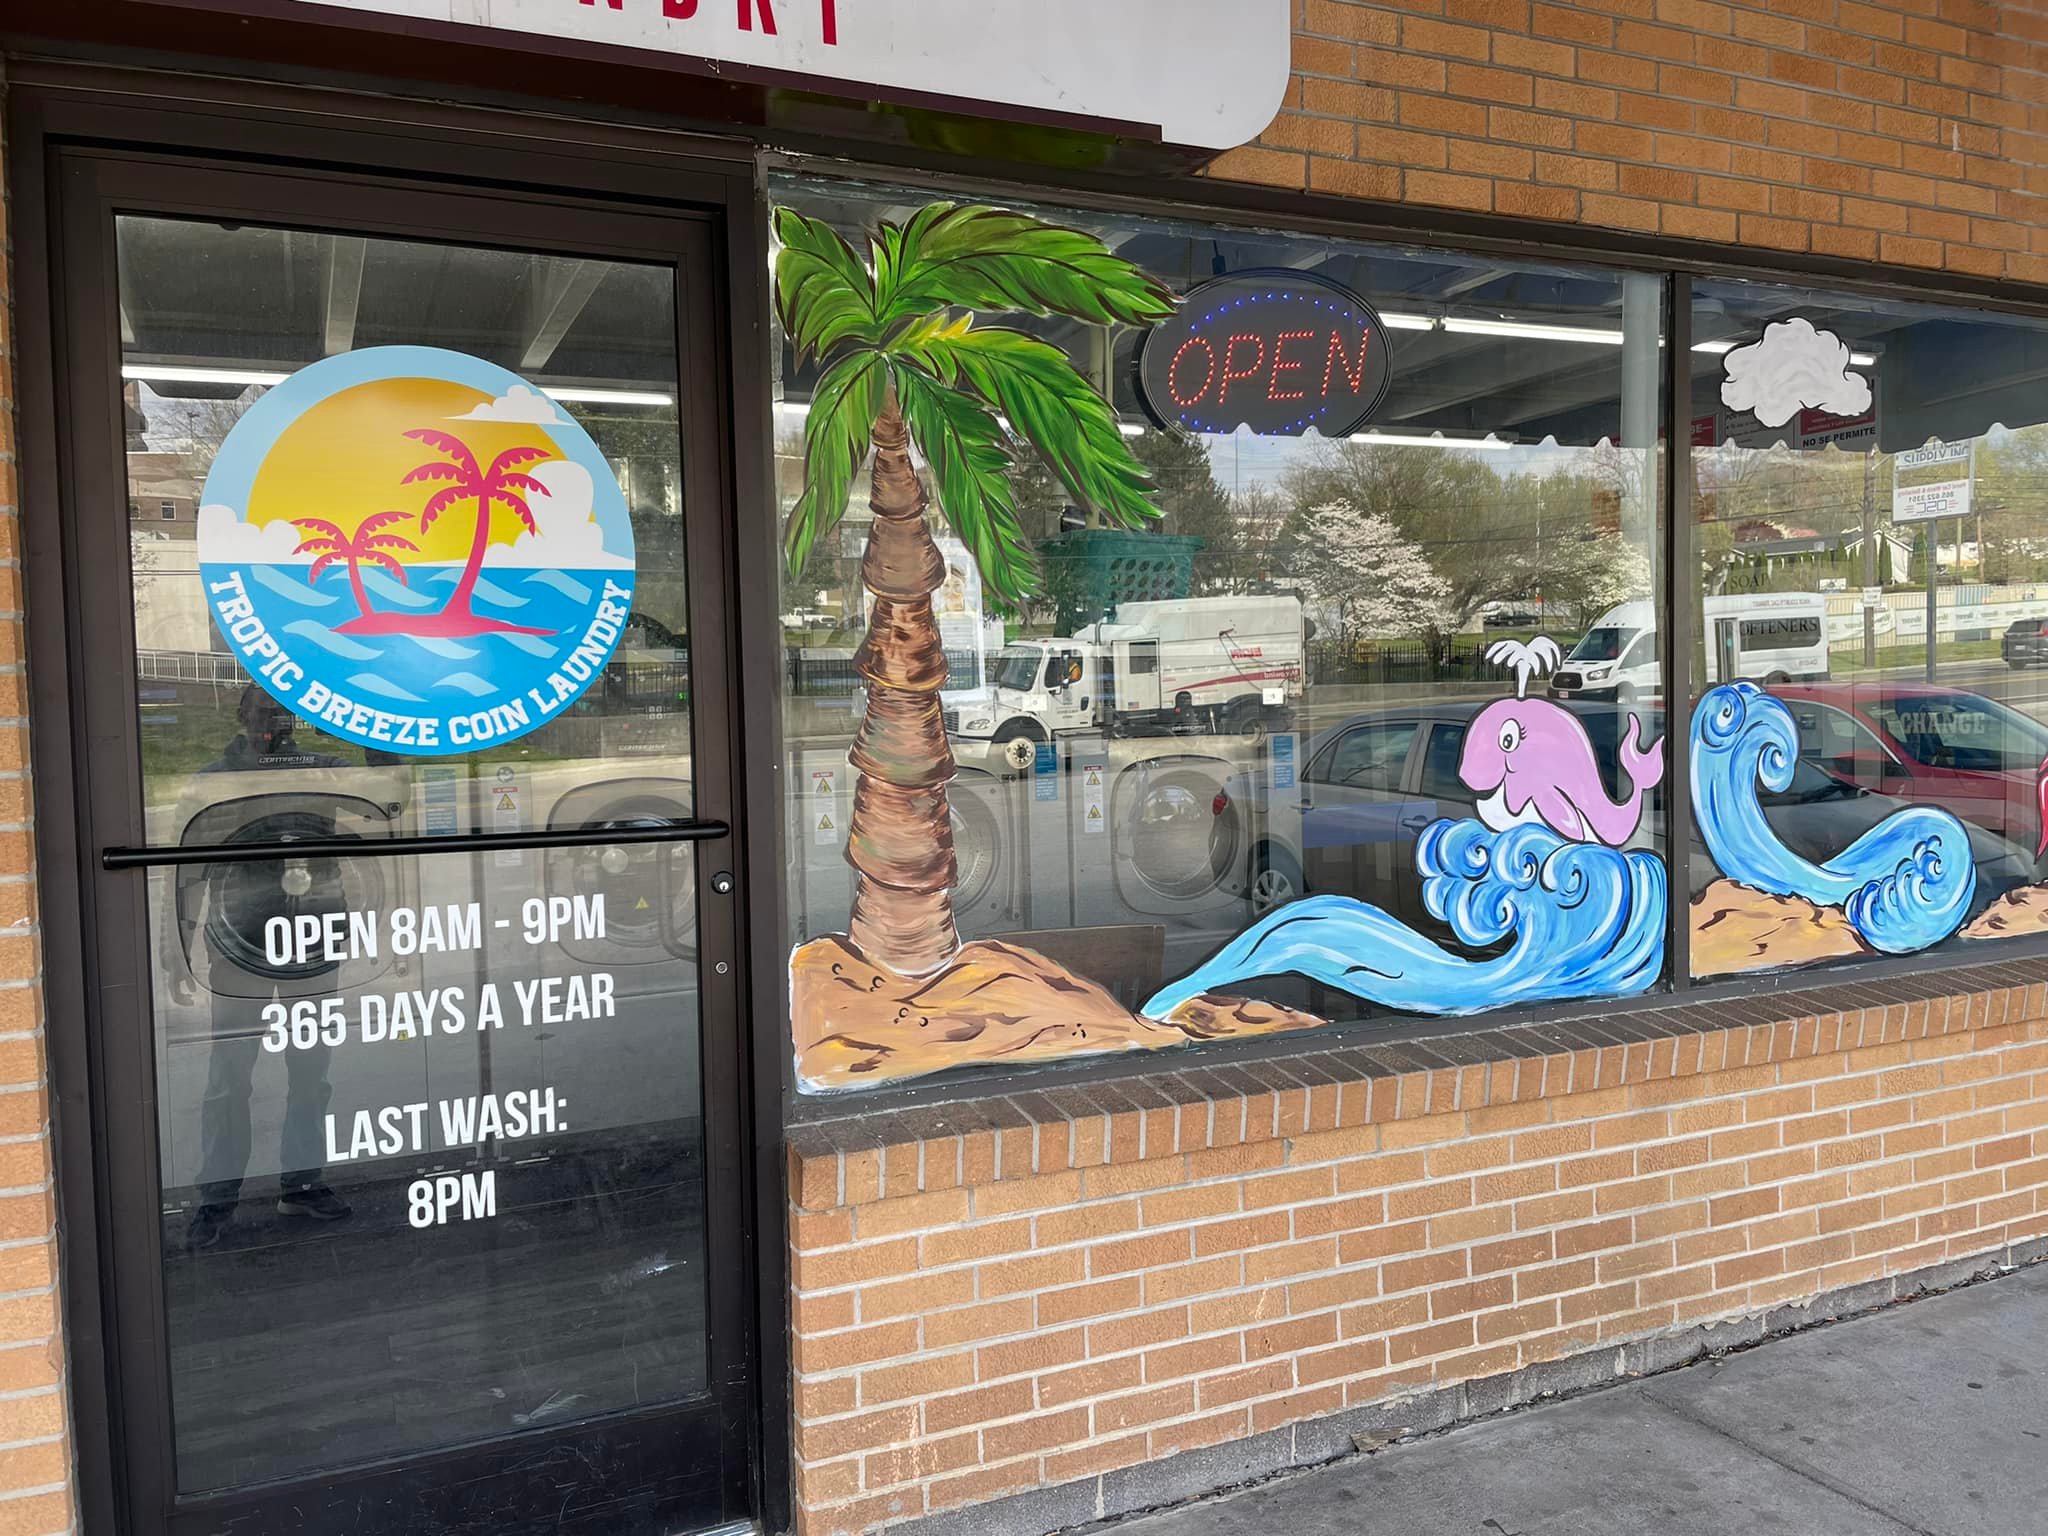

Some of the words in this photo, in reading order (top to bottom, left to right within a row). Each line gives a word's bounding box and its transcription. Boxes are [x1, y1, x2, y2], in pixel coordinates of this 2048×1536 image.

[1168, 328, 1369, 405] OPEN
[1803, 437, 1817, 448] NO
[1819, 434, 1831, 445] SE
[1833, 426, 1876, 441] PERMITE
[1730, 573, 1770, 589] SOAP
[210, 571, 304, 691] TROPIC
[298, 681, 439, 746] BREEZE
[449, 703, 530, 744] COIN
[528, 578, 632, 715] LAUNDRY
[1740, 619, 1818, 636] OFTENERS
[1900, 712, 1985, 734] CHANGE
[264, 910, 378, 966] OPEN
[390, 902, 482, 955] 8AM
[522, 893, 606, 944] 9PM
[261, 997, 347, 1053] 365
[360, 987, 465, 1043] DAYS
[477, 983, 504, 1031] A
[513, 972, 615, 1026] YEAR
[324, 1103, 428, 1163] LAST
[439, 1087, 568, 1146] WASH:
[407, 1170, 497, 1228] 8PM
